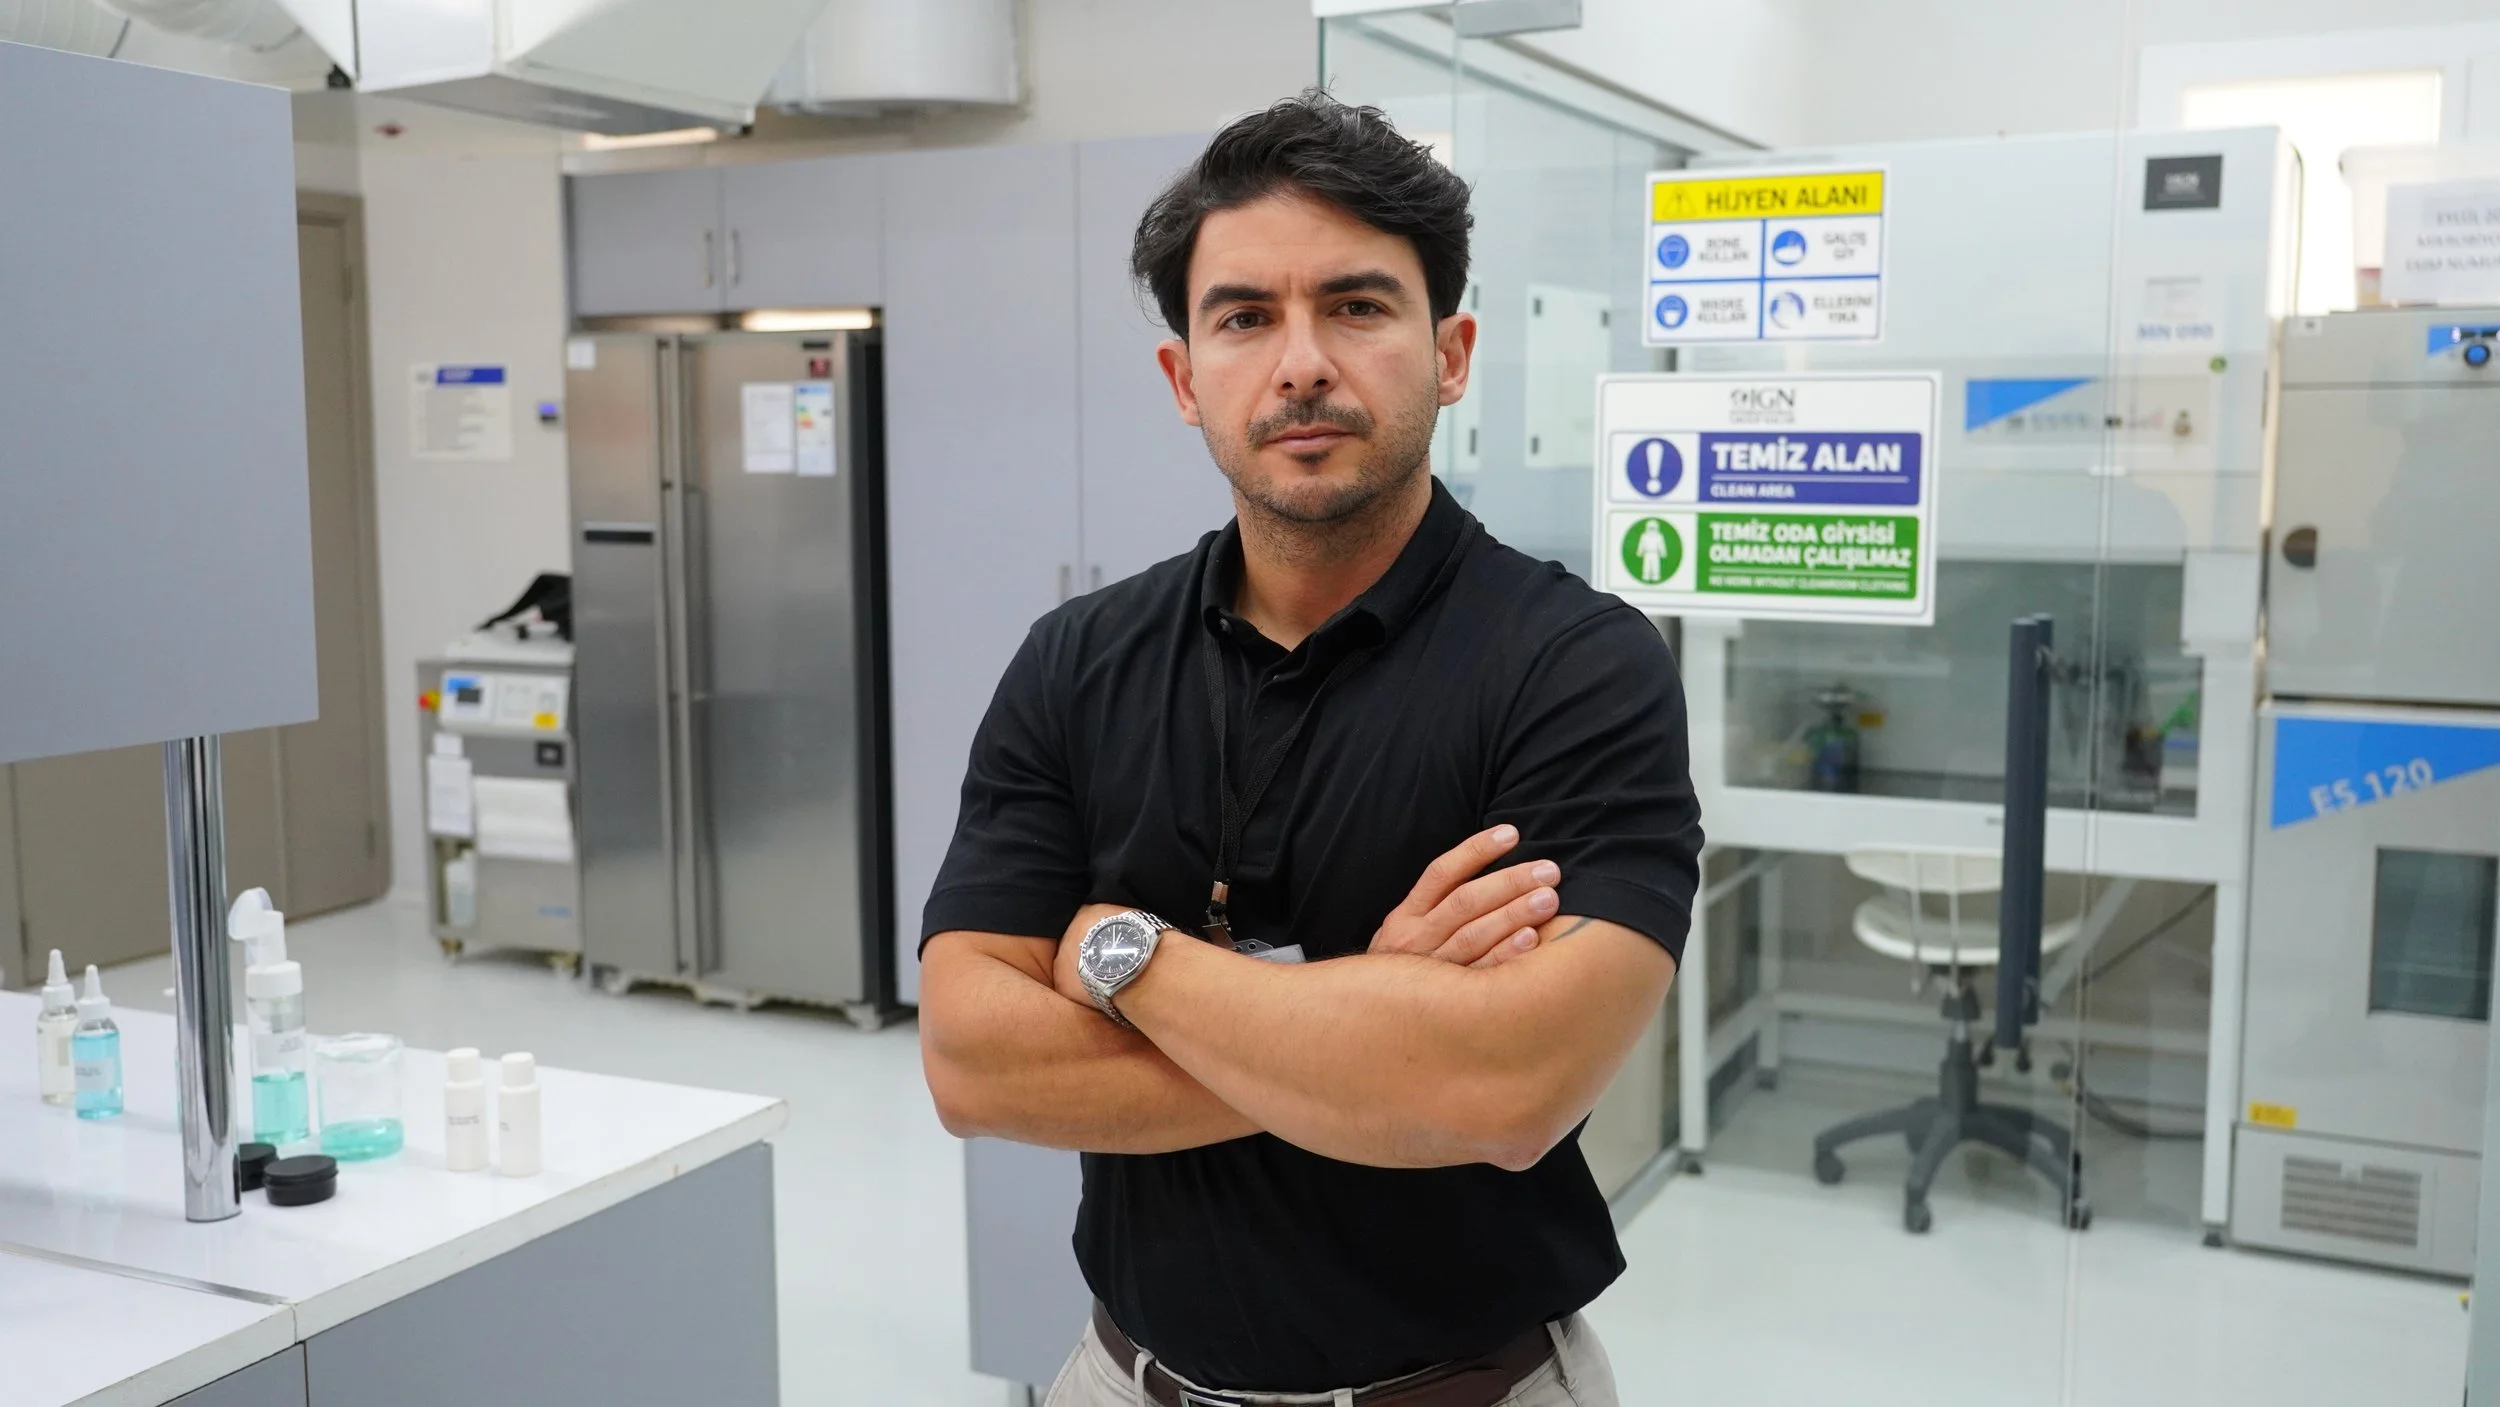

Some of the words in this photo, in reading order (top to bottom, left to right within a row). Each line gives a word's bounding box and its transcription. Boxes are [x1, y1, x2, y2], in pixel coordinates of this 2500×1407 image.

[1796, 185, 1868, 208] ALANI
[1711, 436, 1808, 471] TEMİZ
[1812, 442, 1902, 472] ALAN
[1710, 483, 1756, 498] CLEAN
[1757, 484, 1796, 499] AREA
[1709, 518, 1770, 542] TEMİZ
[1773, 523, 1819, 543] ODA
[1821, 520, 1896, 545] GİYSİSİ
[1709, 543, 1800, 564] OLMADAN
[1803, 546, 1912, 570] ÇALIŞILMAZ
[2309, 779, 2358, 815] ES
[2363, 757, 2433, 801] 120
